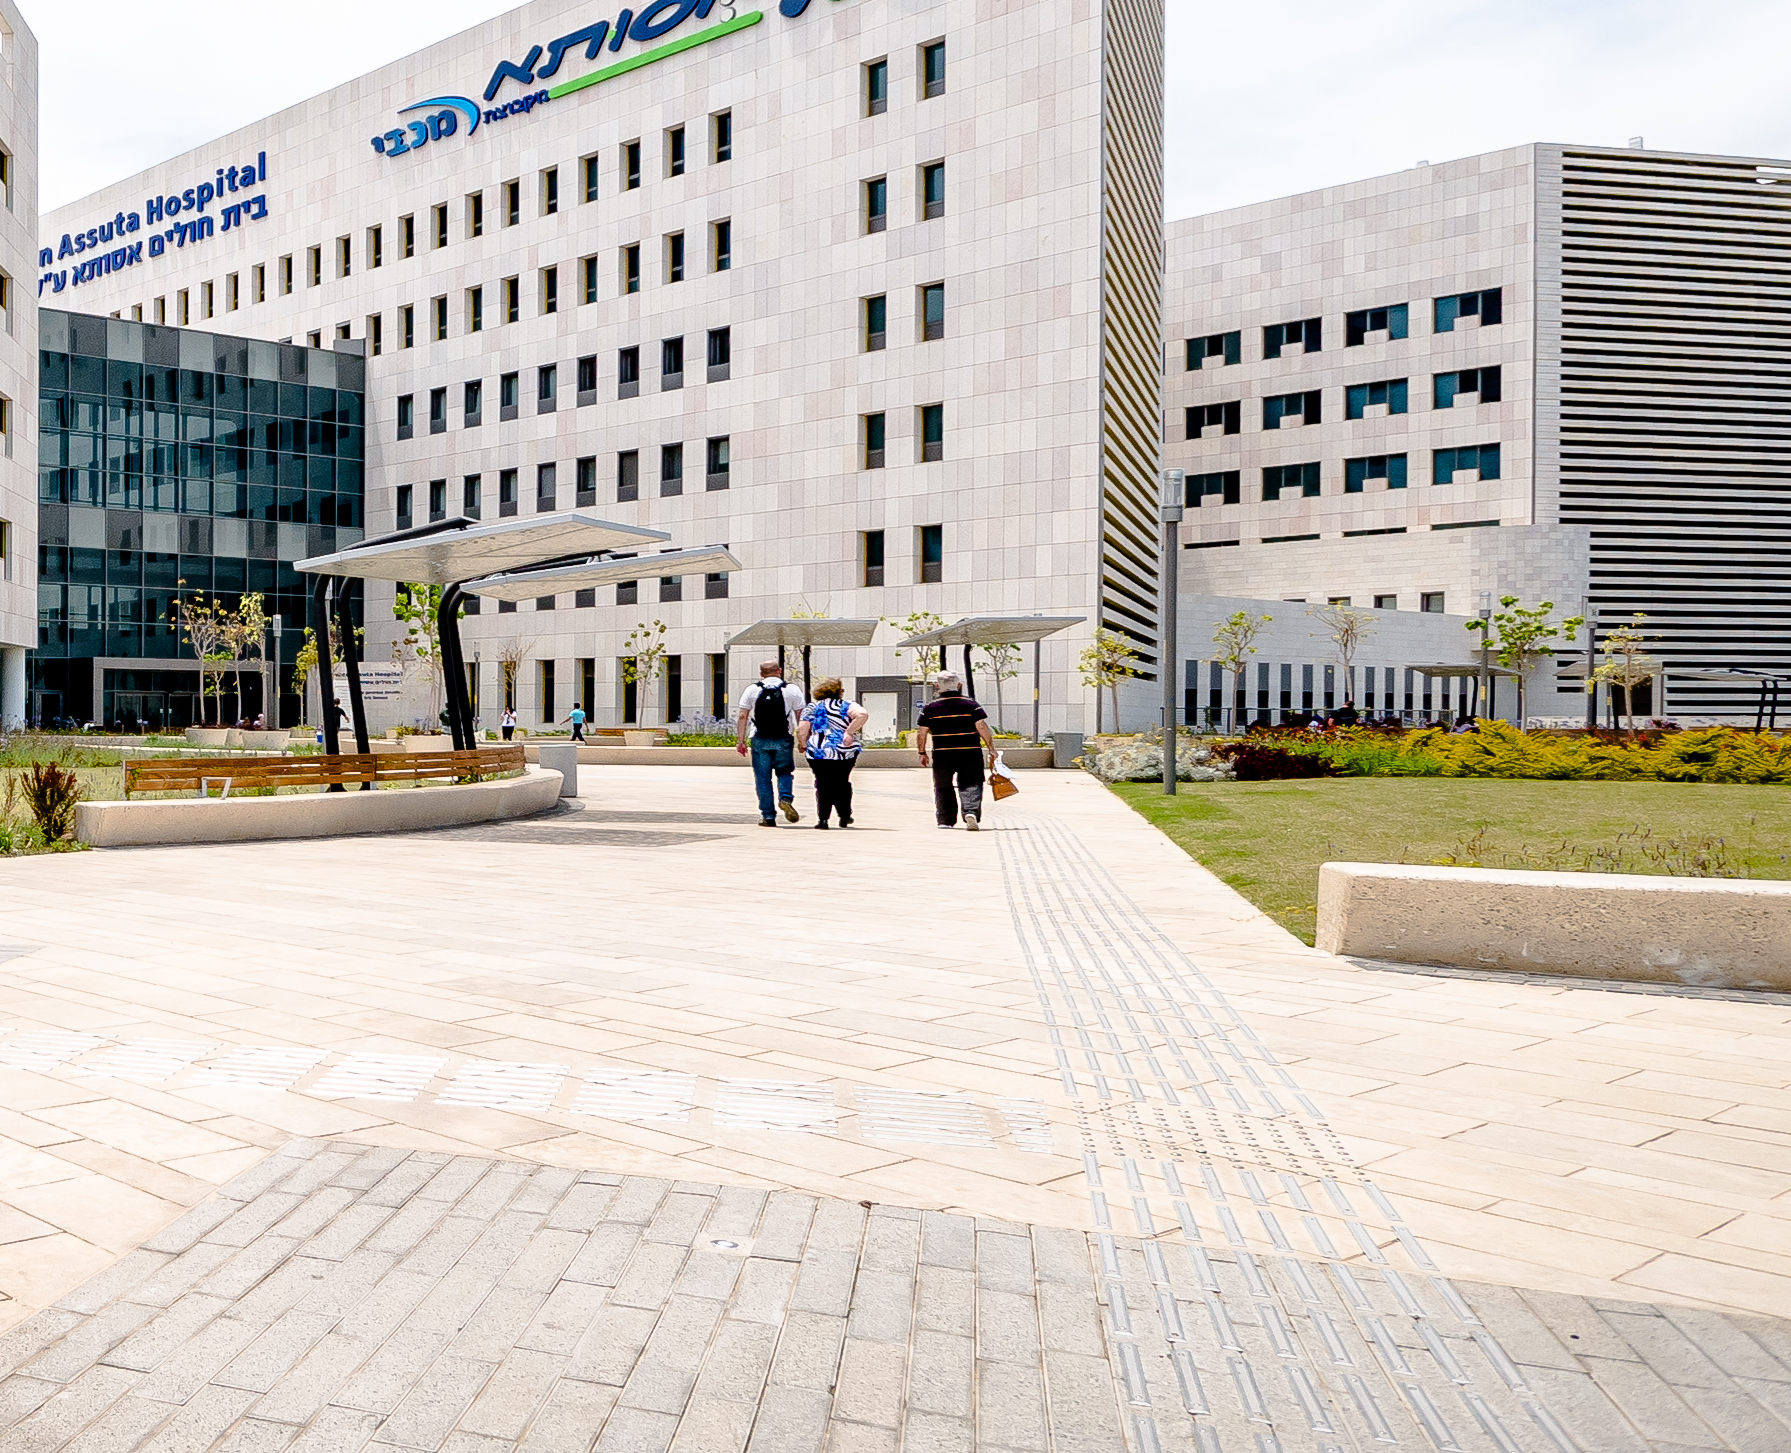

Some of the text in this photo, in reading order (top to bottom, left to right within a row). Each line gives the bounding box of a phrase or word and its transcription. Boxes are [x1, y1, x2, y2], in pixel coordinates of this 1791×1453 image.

[482, 88, 551, 124] מקבוצת
[371, 109, 458, 157] מכבי
[57, 211, 140, 260] Assuta
[146, 150, 267, 225] Hospital
[221, 193, 269, 232] בית
[148, 215, 214, 258] חולים
[71, 240, 143, 287] אסותא
